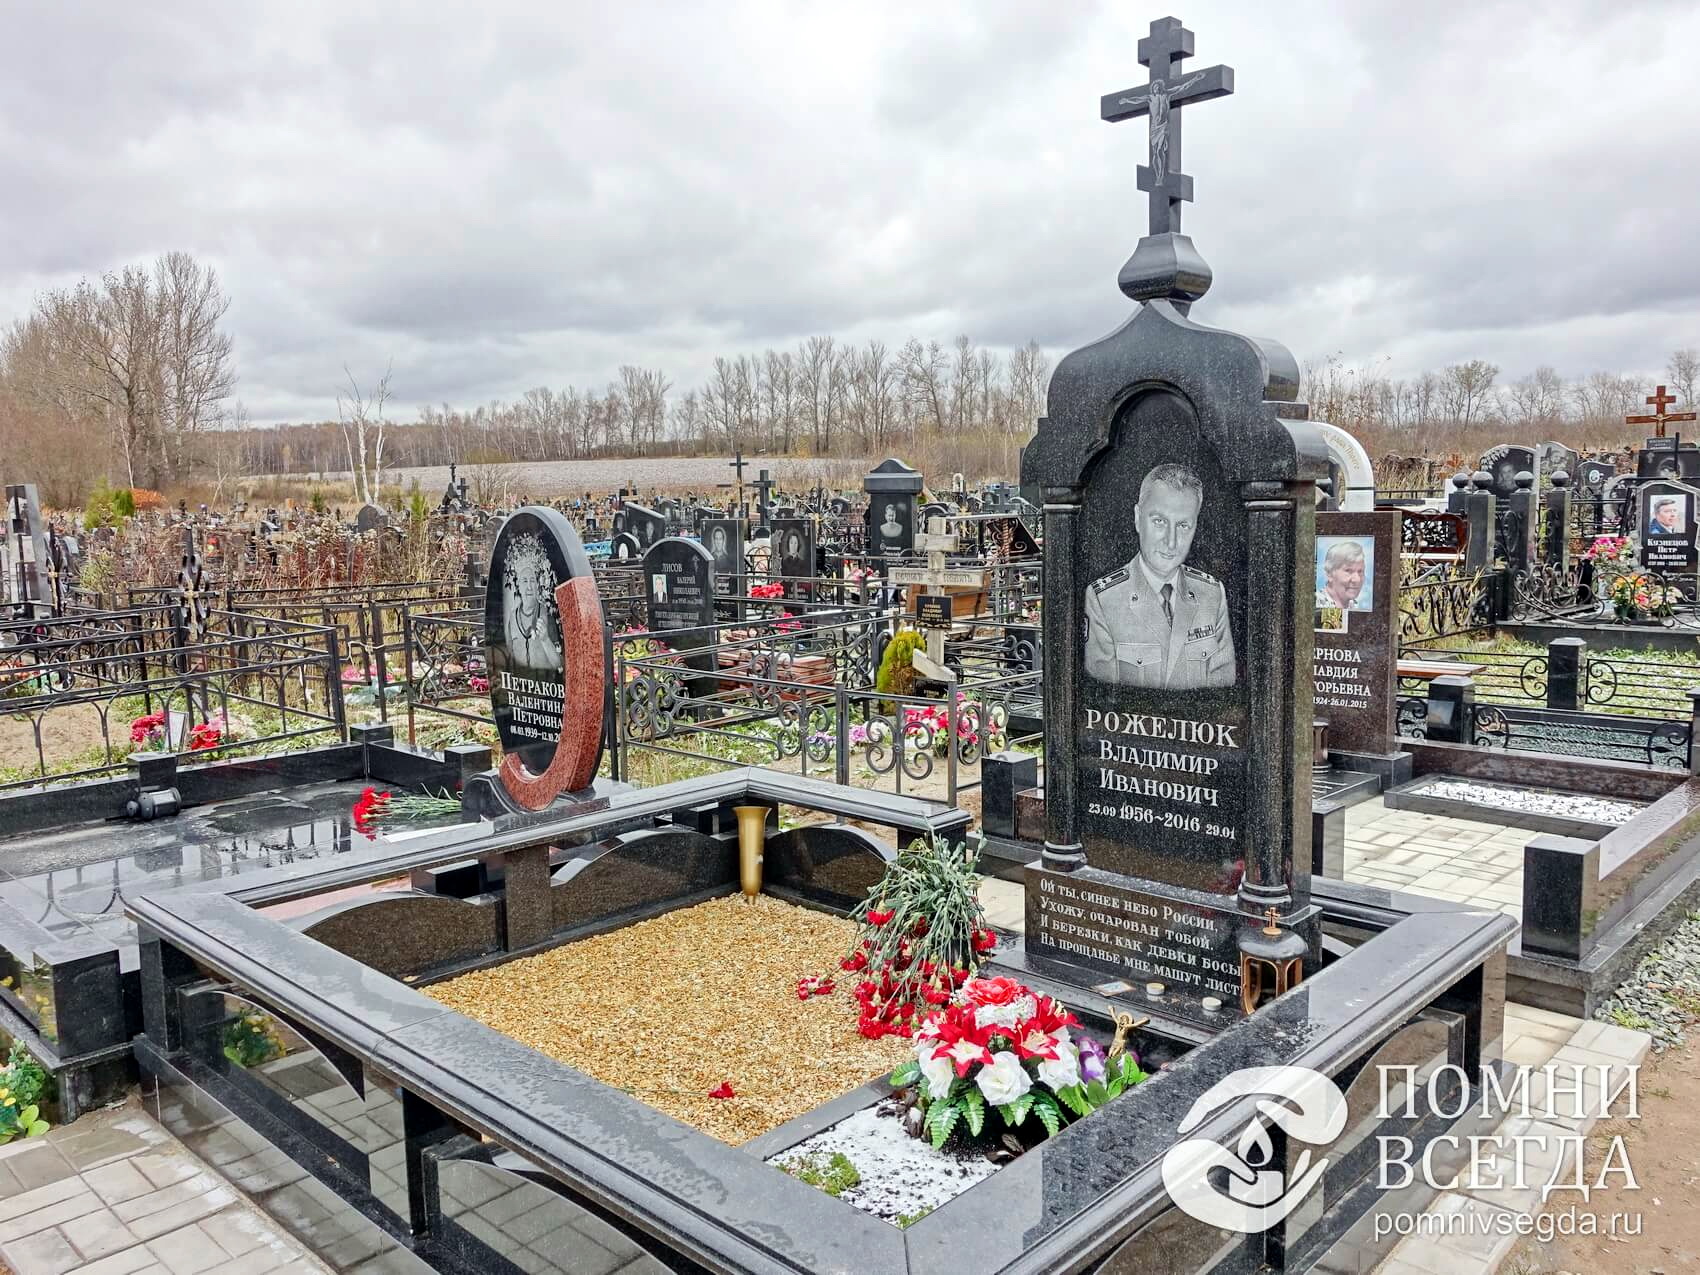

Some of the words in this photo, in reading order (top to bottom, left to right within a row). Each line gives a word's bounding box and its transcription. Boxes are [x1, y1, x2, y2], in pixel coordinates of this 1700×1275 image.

[661, 563, 683, 573] ЛИСОВ
[507, 691, 566, 714] ВАЛЕНТИНА
[512, 706, 564, 729] ПЕТРОВНА
[1085, 708, 1239, 749] РОЖЕЛЮК
[1098, 739, 1219, 776] ВЛАДИМИР
[1099, 767, 1219, 807] ИВАНОВИЧ
[1088, 803, 1117, 817] 23.09
[1205, 823, 1237, 840] 29.01
[1040, 878, 1056, 894] ОЙ
[1080, 891, 1120, 909] СИНЕЕ
[1123, 900, 1158, 918] НЕБО
[1039, 895, 1087, 920] УХОЖУ,
[1089, 911, 1160, 937] ОЧАРОВАН
[1164, 929, 1214, 951] ТОБОЙ.
[1040, 913, 1049, 928] И
[1052, 919, 1114, 945] БЕРЕЗКИ,
[1115, 935, 1143, 953] КАК
[1147, 944, 1198, 966] ДЕВКИ
[1040, 931, 1056, 947] НА
[1059, 938, 1121, 965] ПРОЩАНЬЕ
[1124, 956, 1151, 973] МНЕ
[1153, 963, 1202, 986] МАШУТ
[1204, 977, 1243, 997] ЛИСТ
